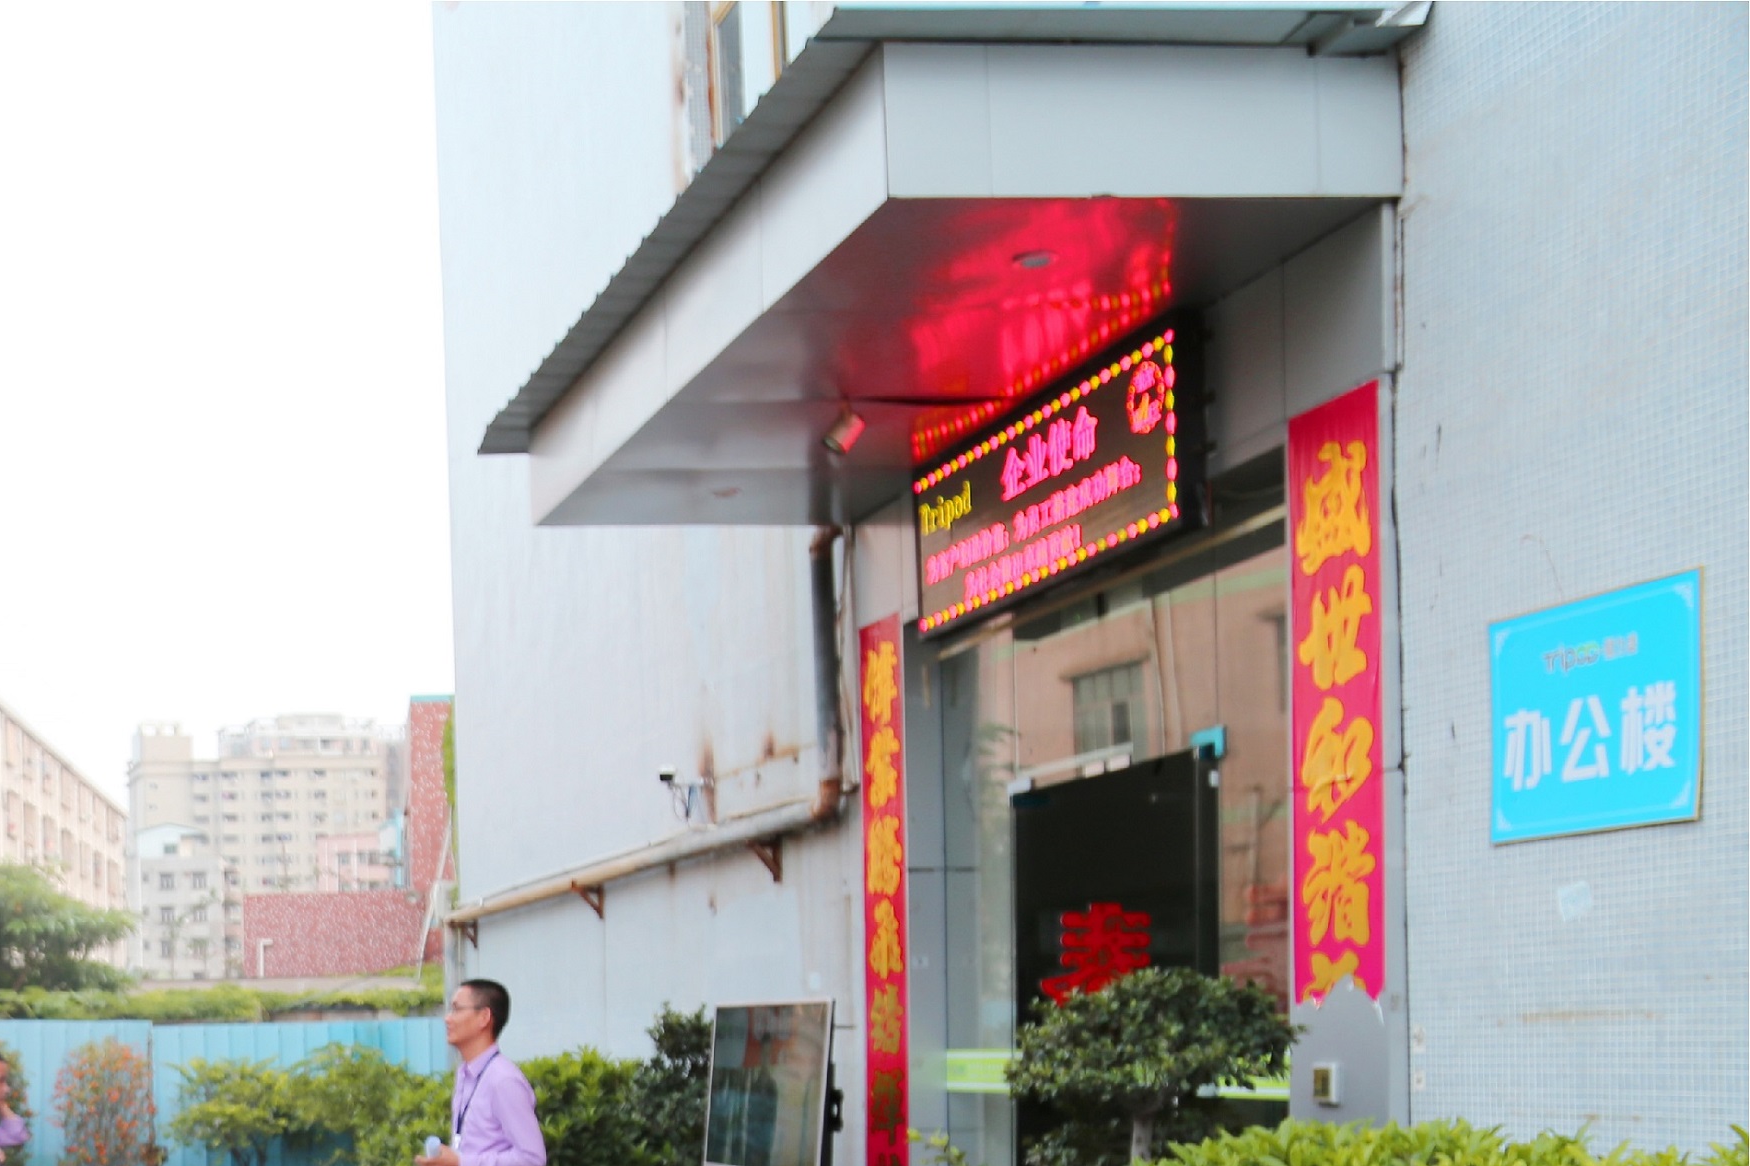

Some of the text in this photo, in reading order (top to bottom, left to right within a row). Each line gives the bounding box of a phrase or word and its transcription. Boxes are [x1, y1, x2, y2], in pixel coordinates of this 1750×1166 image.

[1000, 406, 1098, 502] 企业使命
[919, 480, 972, 537] Tripod
[1504, 681, 1677, 791] 办公楼
